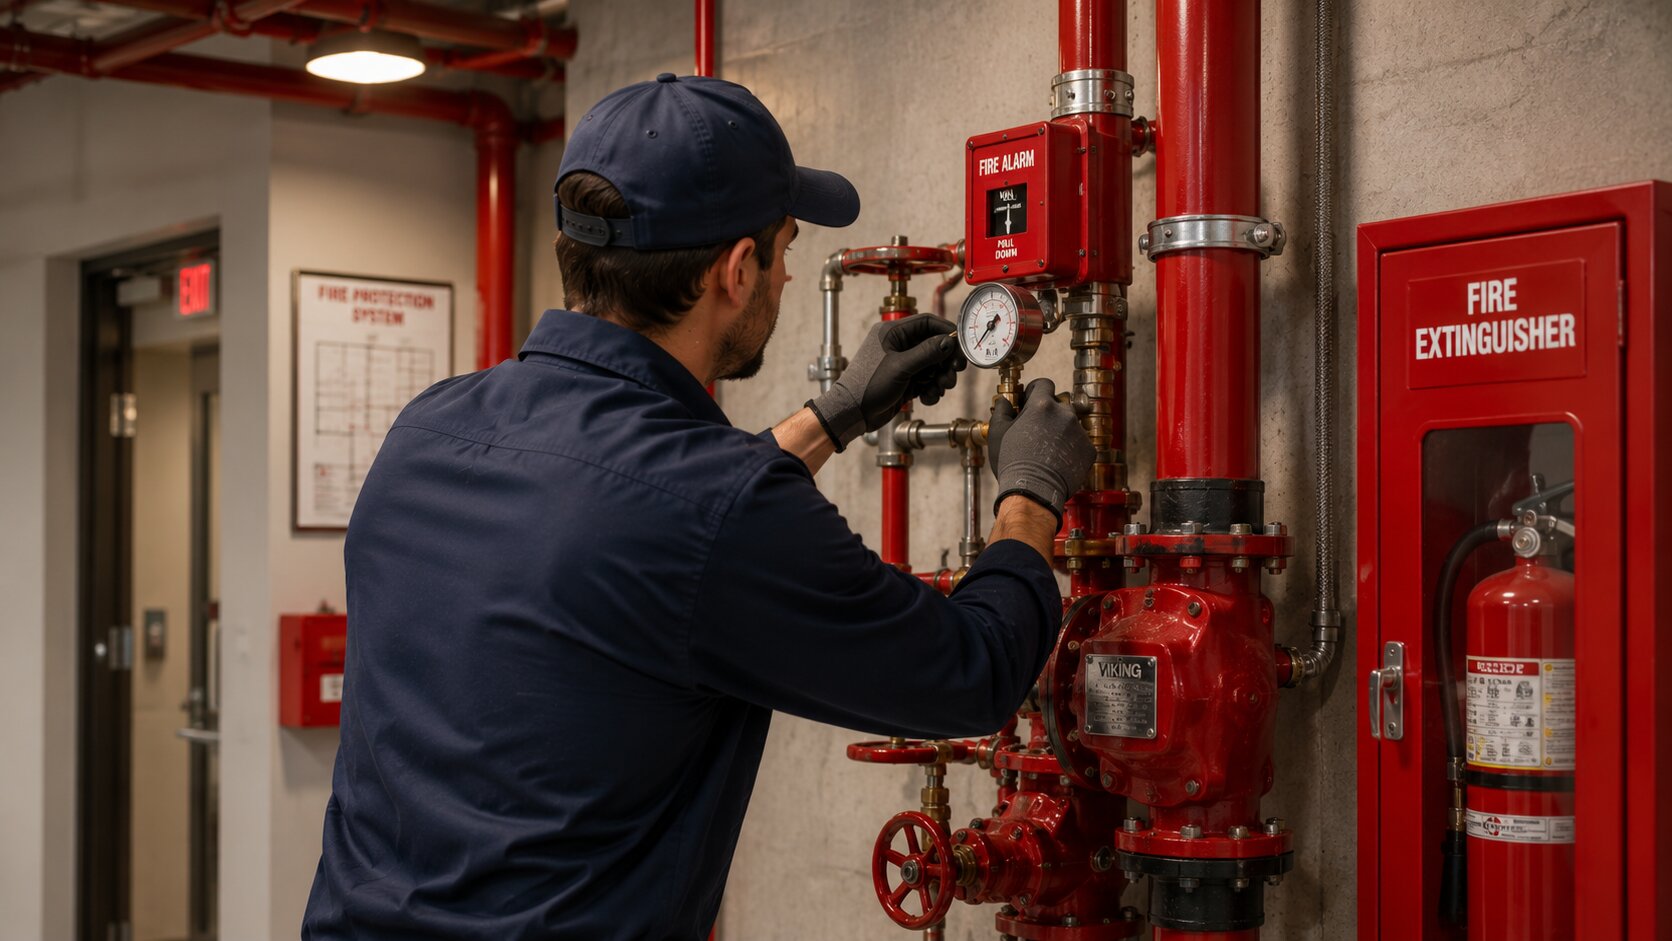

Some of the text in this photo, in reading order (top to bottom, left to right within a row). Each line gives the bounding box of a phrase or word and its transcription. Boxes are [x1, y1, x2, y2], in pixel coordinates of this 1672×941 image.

[979, 149, 1034, 176] FIRE ALARM
[180, 264, 210, 315] EXIT
[318, 285, 434, 309] FIRE PROTECTION
[1467, 277, 1518, 315] FIRE
[353, 307, 405, 325] SYSTEM
[1415, 313, 1576, 360] EXTINGUISHER
[1098, 661, 1142, 679] VIKING
